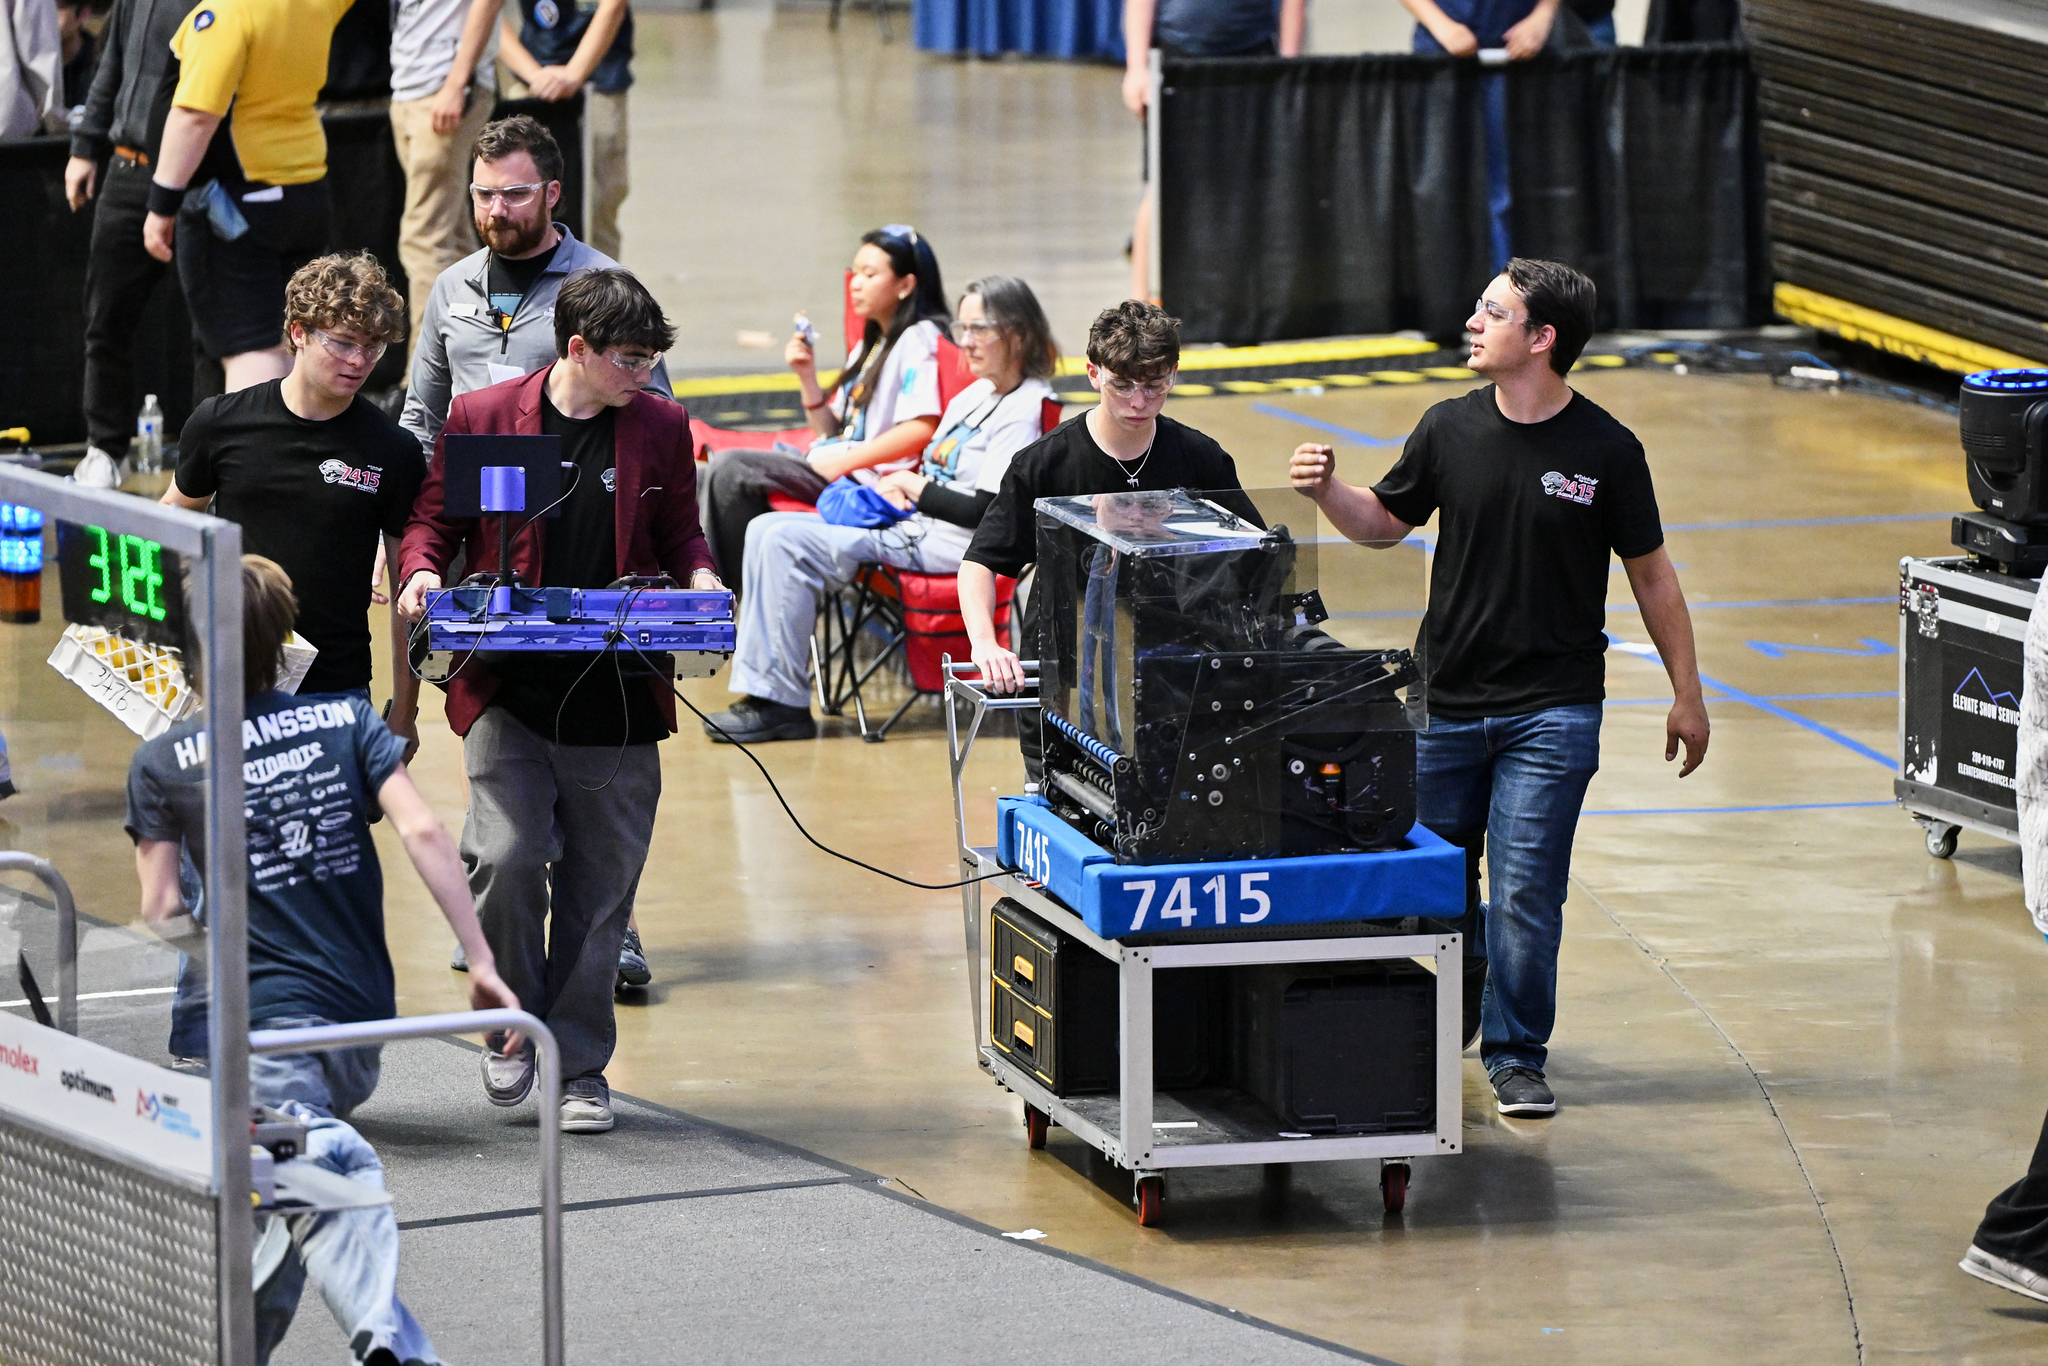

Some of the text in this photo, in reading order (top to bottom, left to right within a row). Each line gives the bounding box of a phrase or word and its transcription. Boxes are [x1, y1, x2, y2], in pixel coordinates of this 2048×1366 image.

[340, 466, 380, 488] 7415
[1560, 479, 1596, 499] 7415
[1953, 693, 1979, 714] ELEVATE
[1980, 700, 1997, 720] SHOW
[243, 741, 326, 785] CTOBOTS
[1017, 821, 1050, 887] 7415
[1122, 871, 1272, 932] 7415
